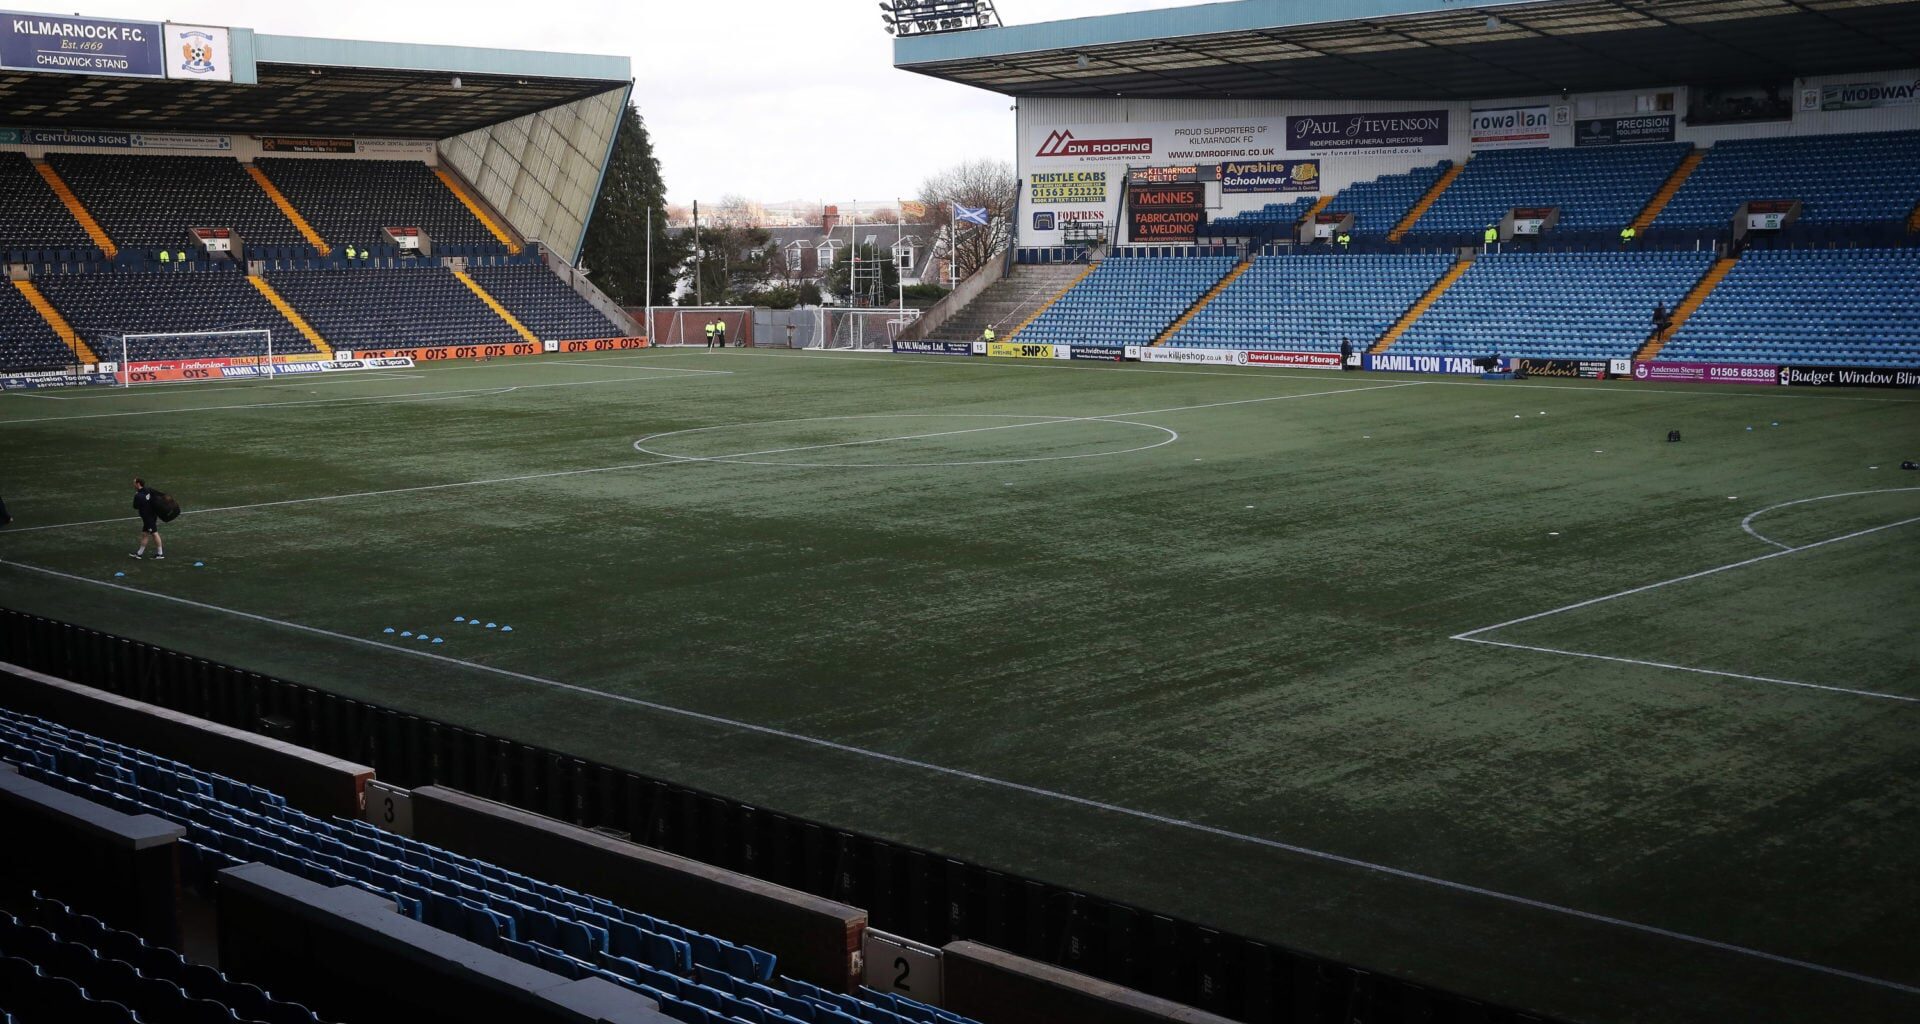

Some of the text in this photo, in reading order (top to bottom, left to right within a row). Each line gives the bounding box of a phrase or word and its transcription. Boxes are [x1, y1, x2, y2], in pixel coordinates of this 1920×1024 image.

[13, 19, 146, 42] KILMARNOCK F.C.
[61, 40, 104, 51] Est. 1869
[37, 54, 128, 69] CHADWICK STAND
[1841, 85, 1915, 102] MODWAY
[1473, 110, 1547, 130] rowallan
[1616, 118, 1670, 129] PRECISION
[1174, 128, 1202, 136] PROUD
[1204, 126, 1255, 135] SUPPORTERS
[1295, 115, 1439, 139] PAUL STEVENSON
[35, 133, 127, 145] CENTURION SIGNS
[1189, 135, 1254, 145] KILMARNOCK FC
[1310, 139, 1354, 147] INDEPENDENT
[1386, 136, 1424, 144] DIRECTORS
[1068, 142, 1151, 154] DM ROOFING
[1168, 148, 1275, 159] WWW.DMROOFING.CO.UK
[1310, 147, 1422, 157] www.funeral-scotland.co.uk
[1148, 166, 1197, 175] KILMARNOCK
[1226, 162, 1285, 174] Ayrshire
[1031, 172, 1106, 183] THISTLE CABS
[1223, 176, 1287, 186] Schoolwear
[1032, 187, 1105, 197] 01563 522222
[1139, 192, 1194, 204] McINNES
[1057, 210, 1105, 221] FORTRESS
[1135, 212, 1199, 223] FABRICATION
[1139, 224, 1195, 234] & WELDING
[896, 341, 931, 350] W.W.Wales
[932, 343, 946, 351] Ltd.
[1021, 345, 1041, 357] SNP
[1128, 348, 1137, 356] 16
[1250, 353, 1269, 361] David
[1270, 354, 1294, 363] Lindsay
[1294, 355, 1309, 363] Self
[1310, 356, 1339, 365] Storage
[1372, 356, 1440, 372] HAMILTON
[128, 365, 176, 373] Ladbroks
[222, 362, 321, 377] HAMILTON TARMAC
[339, 361, 361, 369] Sport
[1520, 358, 1578, 377] Cecchini's
[1616, 362, 1625, 370] 18
[1710, 367, 1739, 377] 01505
[1741, 368, 1775, 378] 683368
[1791, 369, 1920, 385] Budget Window Blin
[26, 376, 63, 384] Precision
[63, 374, 92, 383] Tooing
[384, 797, 394, 823] 3
[894, 956, 910, 992] 2
